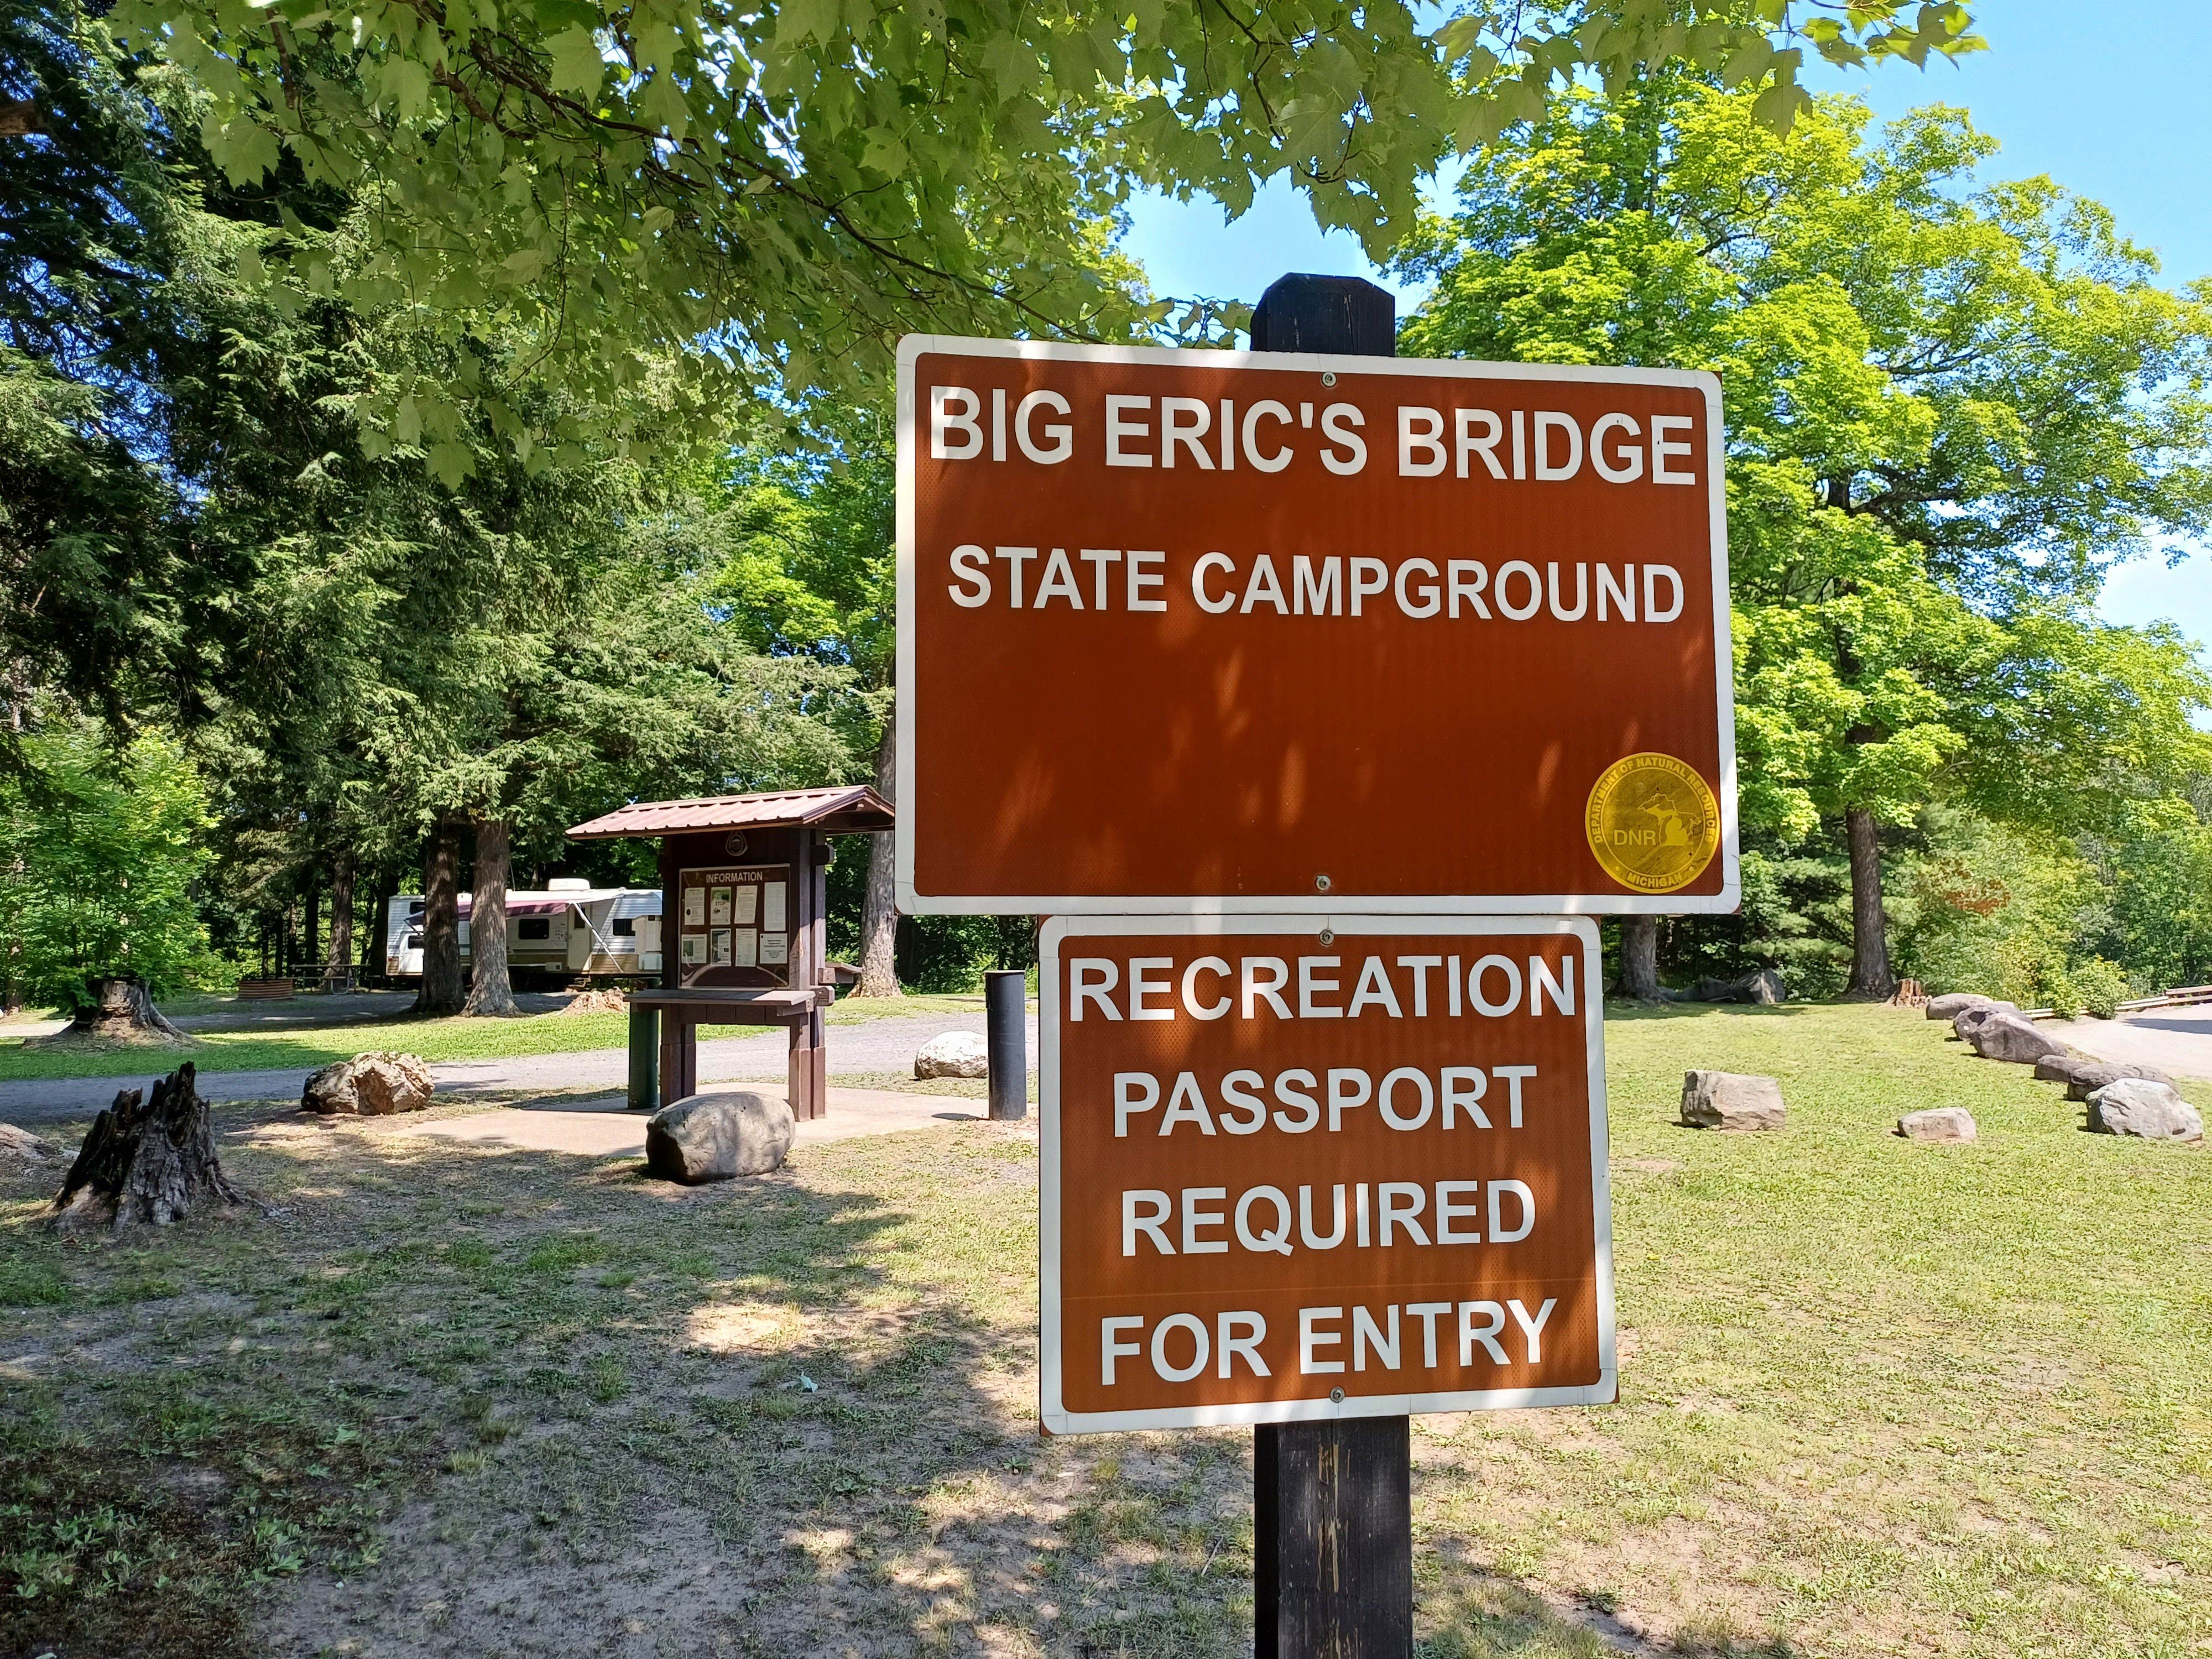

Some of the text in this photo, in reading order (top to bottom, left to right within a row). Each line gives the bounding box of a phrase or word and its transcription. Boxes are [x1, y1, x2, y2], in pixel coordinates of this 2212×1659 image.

[931, 385, 1695, 486] BIG ERIC'S BRIDGE
[948, 544, 1684, 623] STATE CAMPGROUND
[1591, 757, 1716, 843] DEPARTMENT OF NATURAL RESOURCES
[1614, 830, 1656, 846] DNR
[706, 872, 763, 883] INFORMATION
[1626, 872, 1683, 887] MICHIGAN
[1068, 954, 1575, 1021] RECREATION
[1114, 1065, 1537, 1138] PASSPORT
[1122, 1179, 1536, 1257] REQUIRED
[1102, 1298, 1558, 1386] FOR ENTRY
